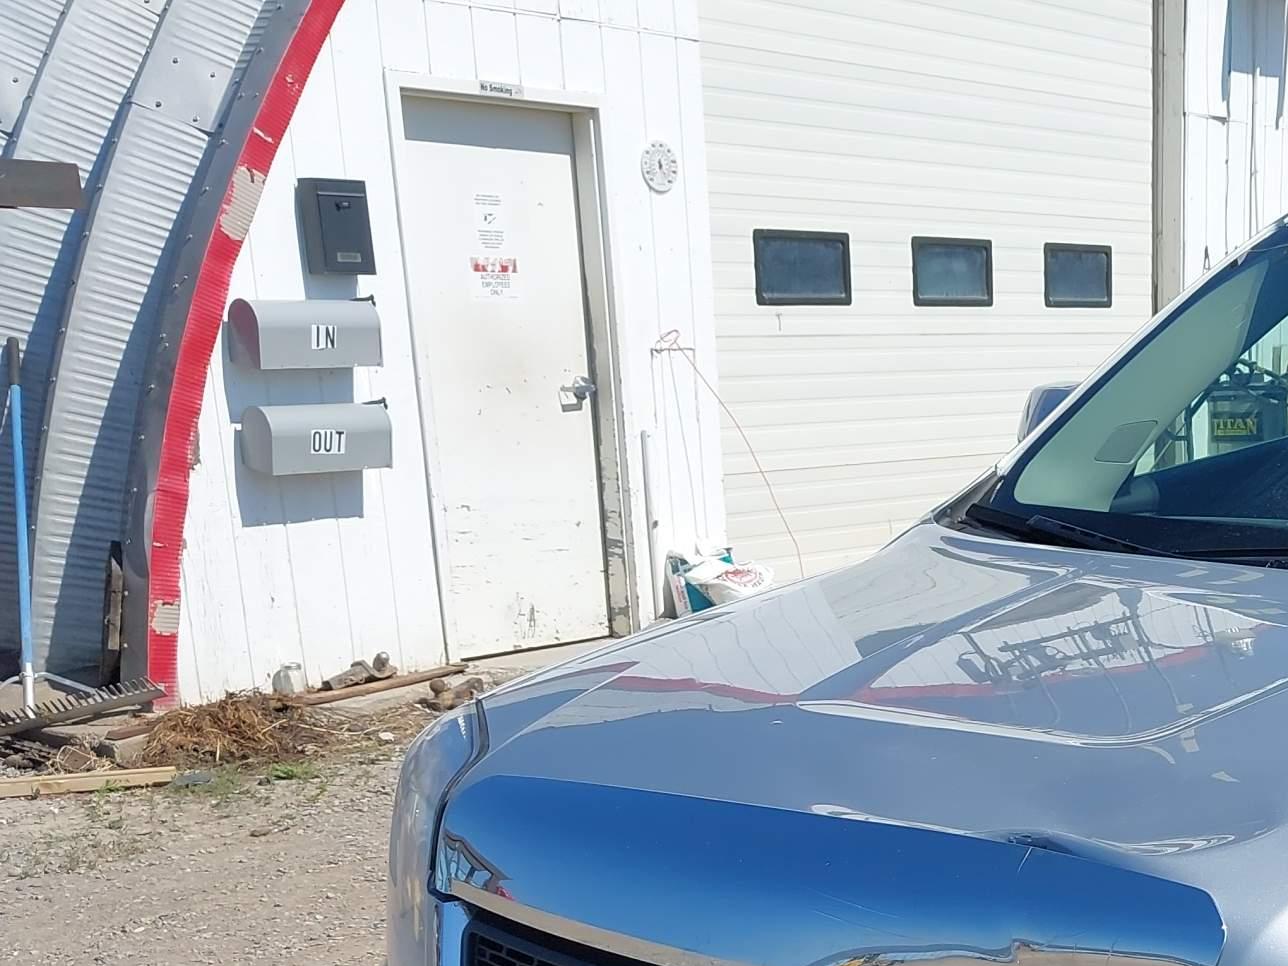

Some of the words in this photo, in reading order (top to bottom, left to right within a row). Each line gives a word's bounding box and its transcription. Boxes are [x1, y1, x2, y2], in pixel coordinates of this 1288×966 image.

[480, 83, 489, 92] No
[489, 83, 513, 96] Smoking
[480, 273, 511, 281] AUTHORIZED
[481, 281, 511, 289] EMPLOYEES
[316, 325, 335, 349] IN
[1213, 418, 1257, 435] TITAN
[312, 430, 344, 453] OUT
